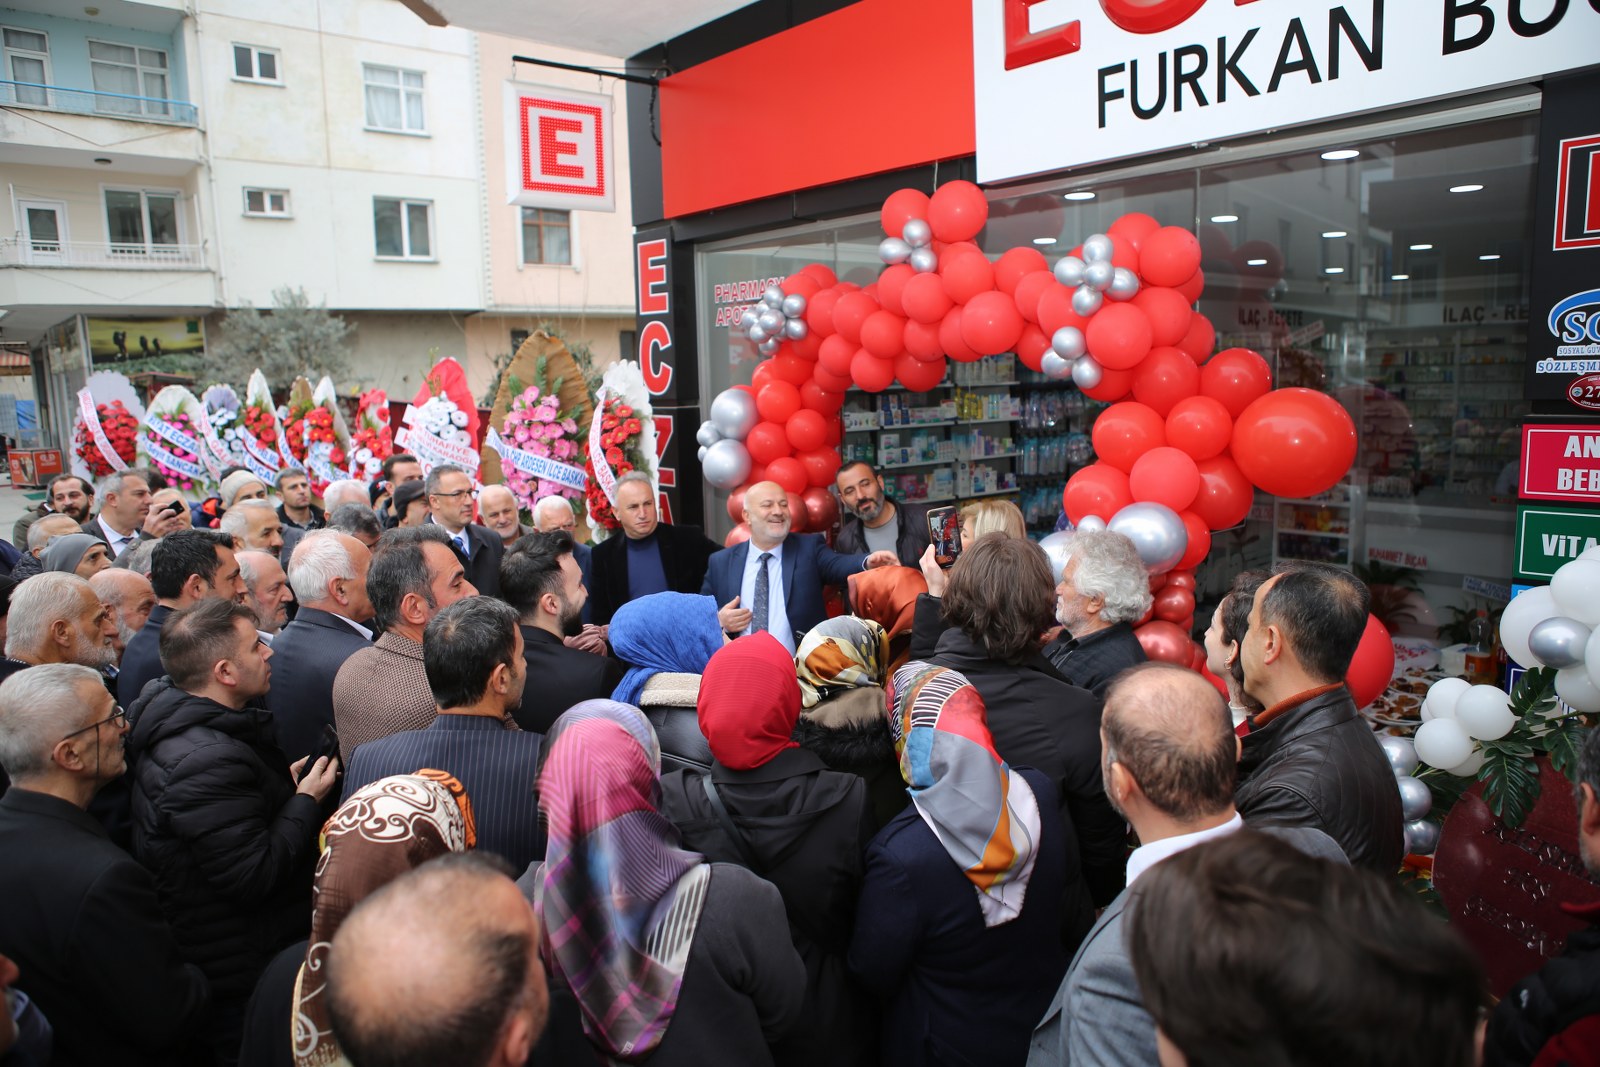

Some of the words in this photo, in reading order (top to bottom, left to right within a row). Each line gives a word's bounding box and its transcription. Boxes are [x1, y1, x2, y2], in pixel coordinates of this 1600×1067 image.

[1098, 0, 1385, 128] FURKAN
[538, 115, 584, 179] E
[1538, 359, 1600, 374] SÖZLEŞM
[1559, 346, 1584, 355] SOSYAL
